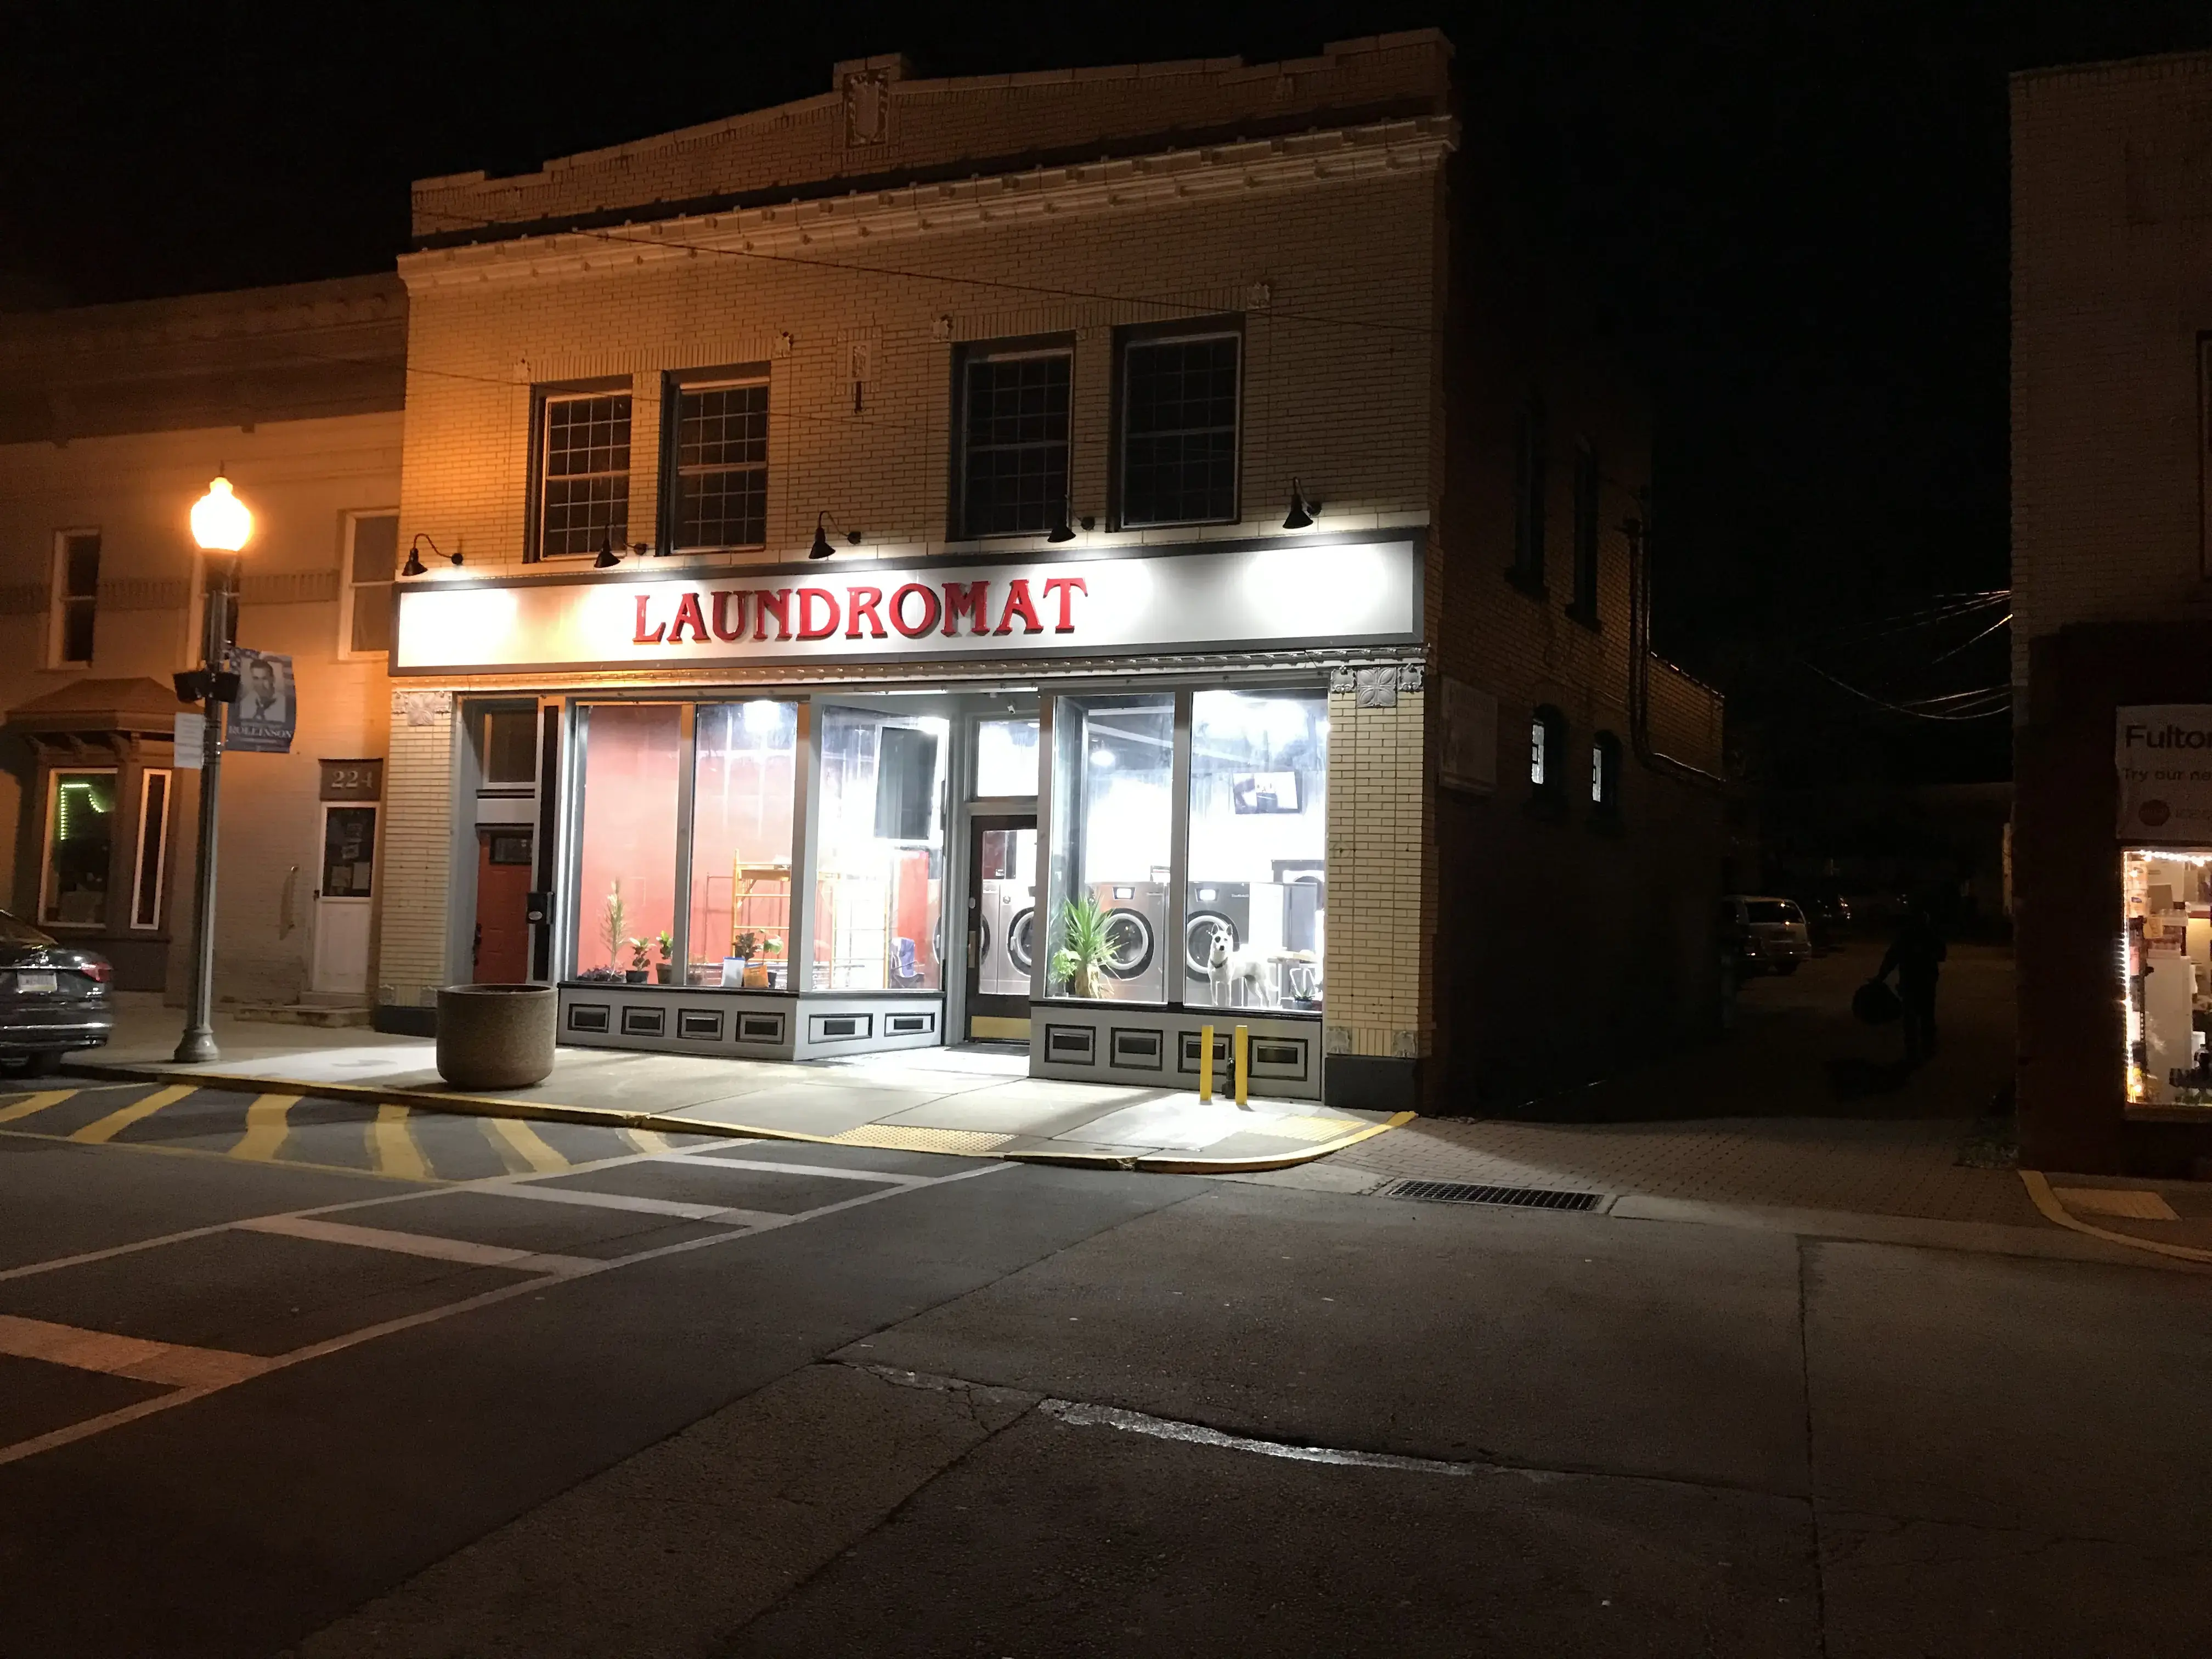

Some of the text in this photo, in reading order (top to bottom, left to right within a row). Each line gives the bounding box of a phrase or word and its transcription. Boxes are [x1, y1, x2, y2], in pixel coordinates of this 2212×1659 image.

[633, 577, 1088, 646] LAUNDROMAT
[228, 725, 292, 738] ROLLINSON
[2123, 768, 2148, 782] Try
[2154, 771, 2183, 781] our
